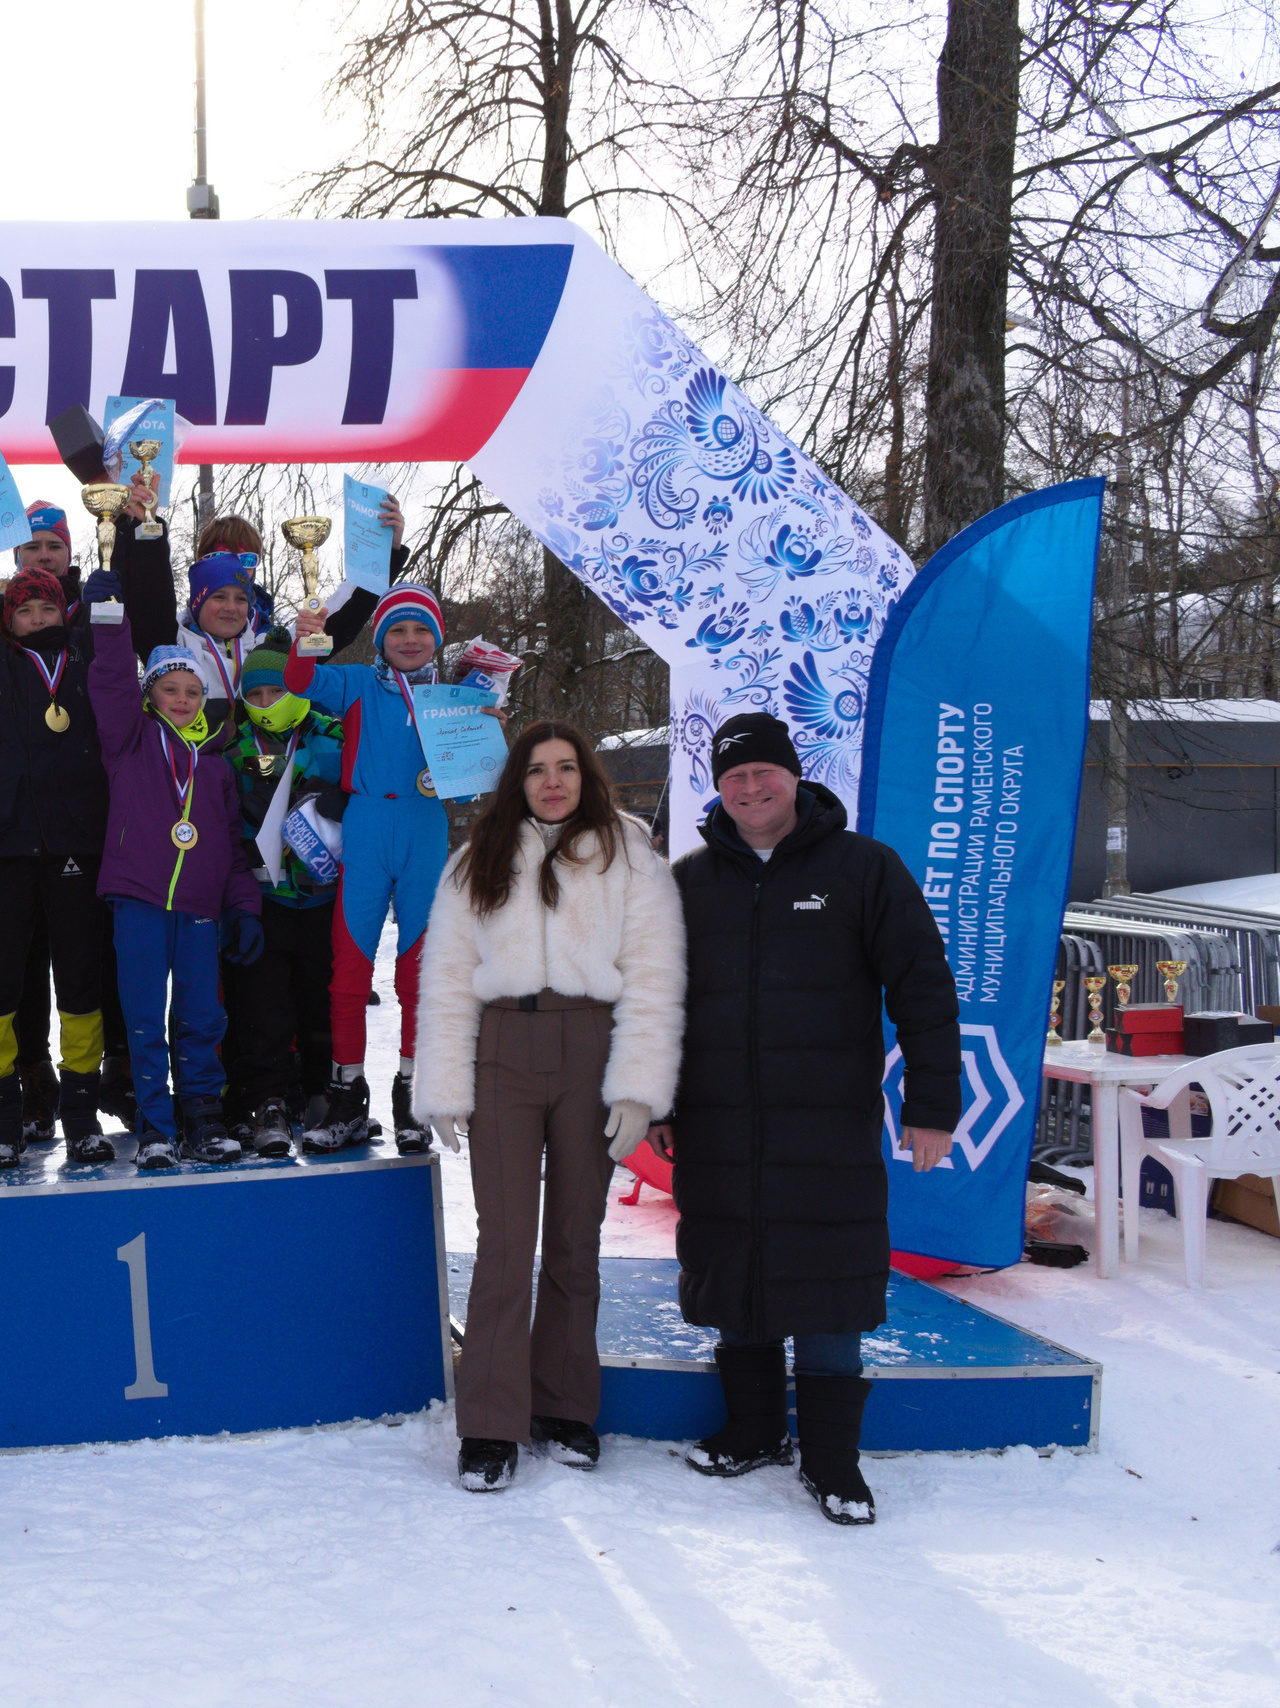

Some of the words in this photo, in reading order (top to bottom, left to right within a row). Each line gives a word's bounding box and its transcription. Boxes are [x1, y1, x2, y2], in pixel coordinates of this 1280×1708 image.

[347, 498, 380, 519] ГРАМОТ
[423, 705, 483, 720] ГРАМОТА
[933, 702, 965, 813] СПОРТУ
[970, 702, 993, 828] РАМЕНСКОГО
[998, 744, 1024, 815] ОКРУГА
[928, 822, 961, 859] ПО
[793, 901, 821, 910] PUMA
[923, 866, 954, 960] ИТЕТ
[956, 834, 986, 1002] АДМИНИСТРАЦИИ
[980, 821, 1018, 1002] МУНИЦИПАЛЬНОГО
[116, 1232, 168, 1401] 1
